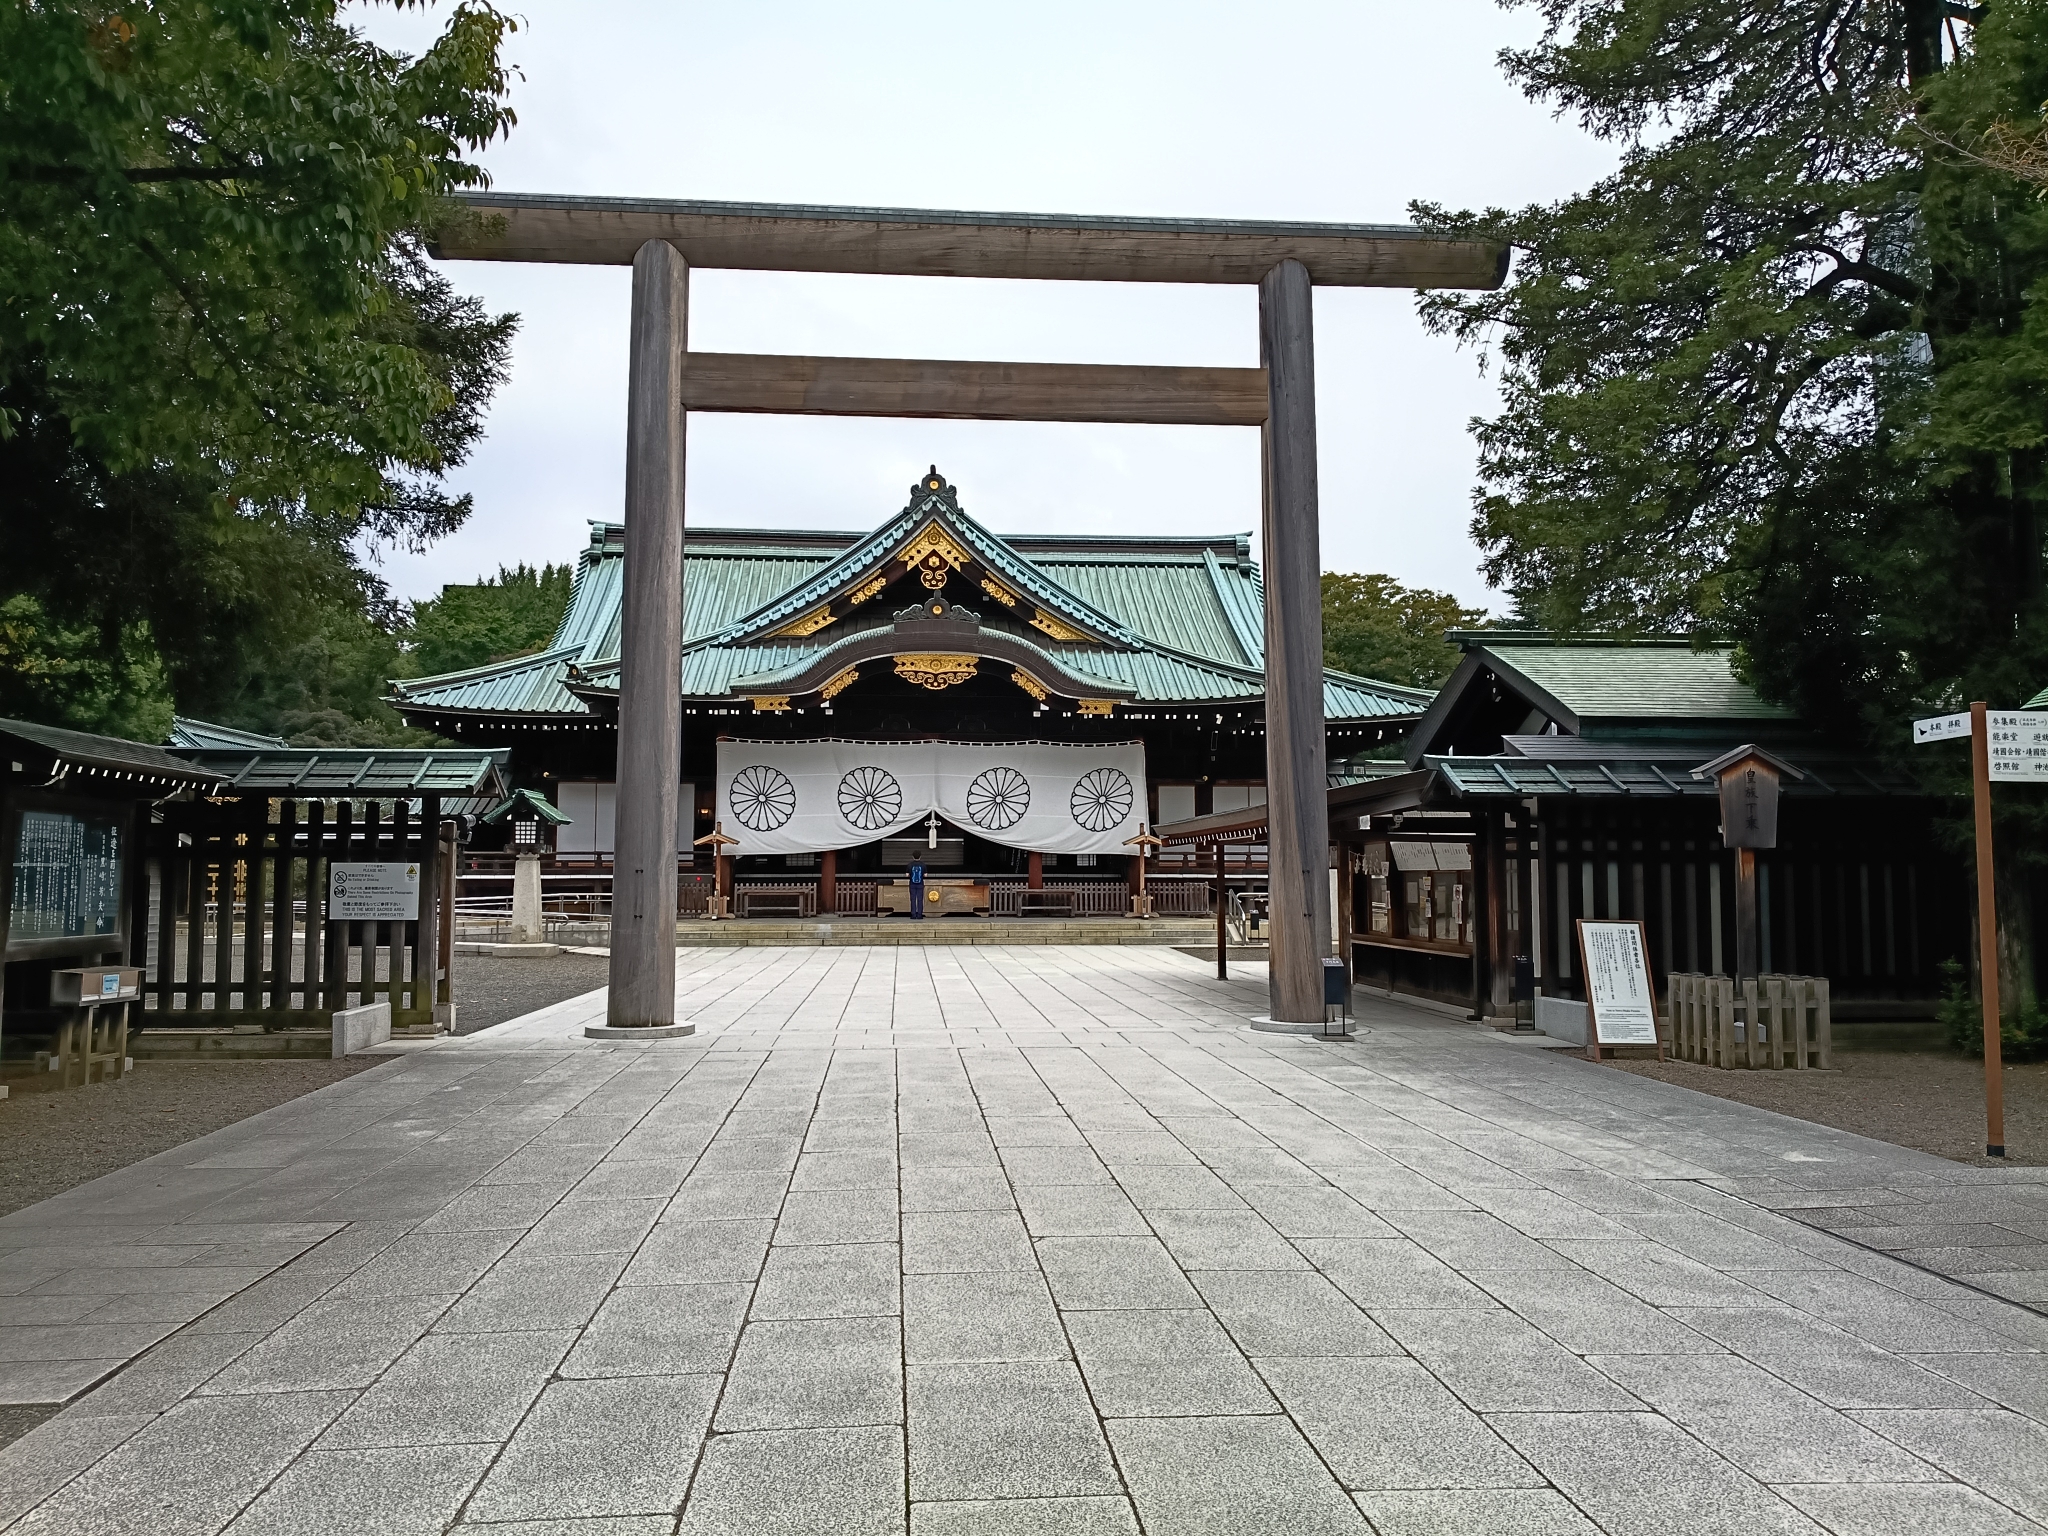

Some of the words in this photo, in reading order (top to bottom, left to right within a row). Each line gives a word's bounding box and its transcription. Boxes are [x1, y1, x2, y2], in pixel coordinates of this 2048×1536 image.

[1930, 722, 1942, 731] 本殿
[1948, 719, 1961, 729] 拝殿
[1992, 717, 2018, 727] 参集殿
[1992, 732, 2019, 742] 能楽堂
[1993, 762, 2020, 771] 啓照館
